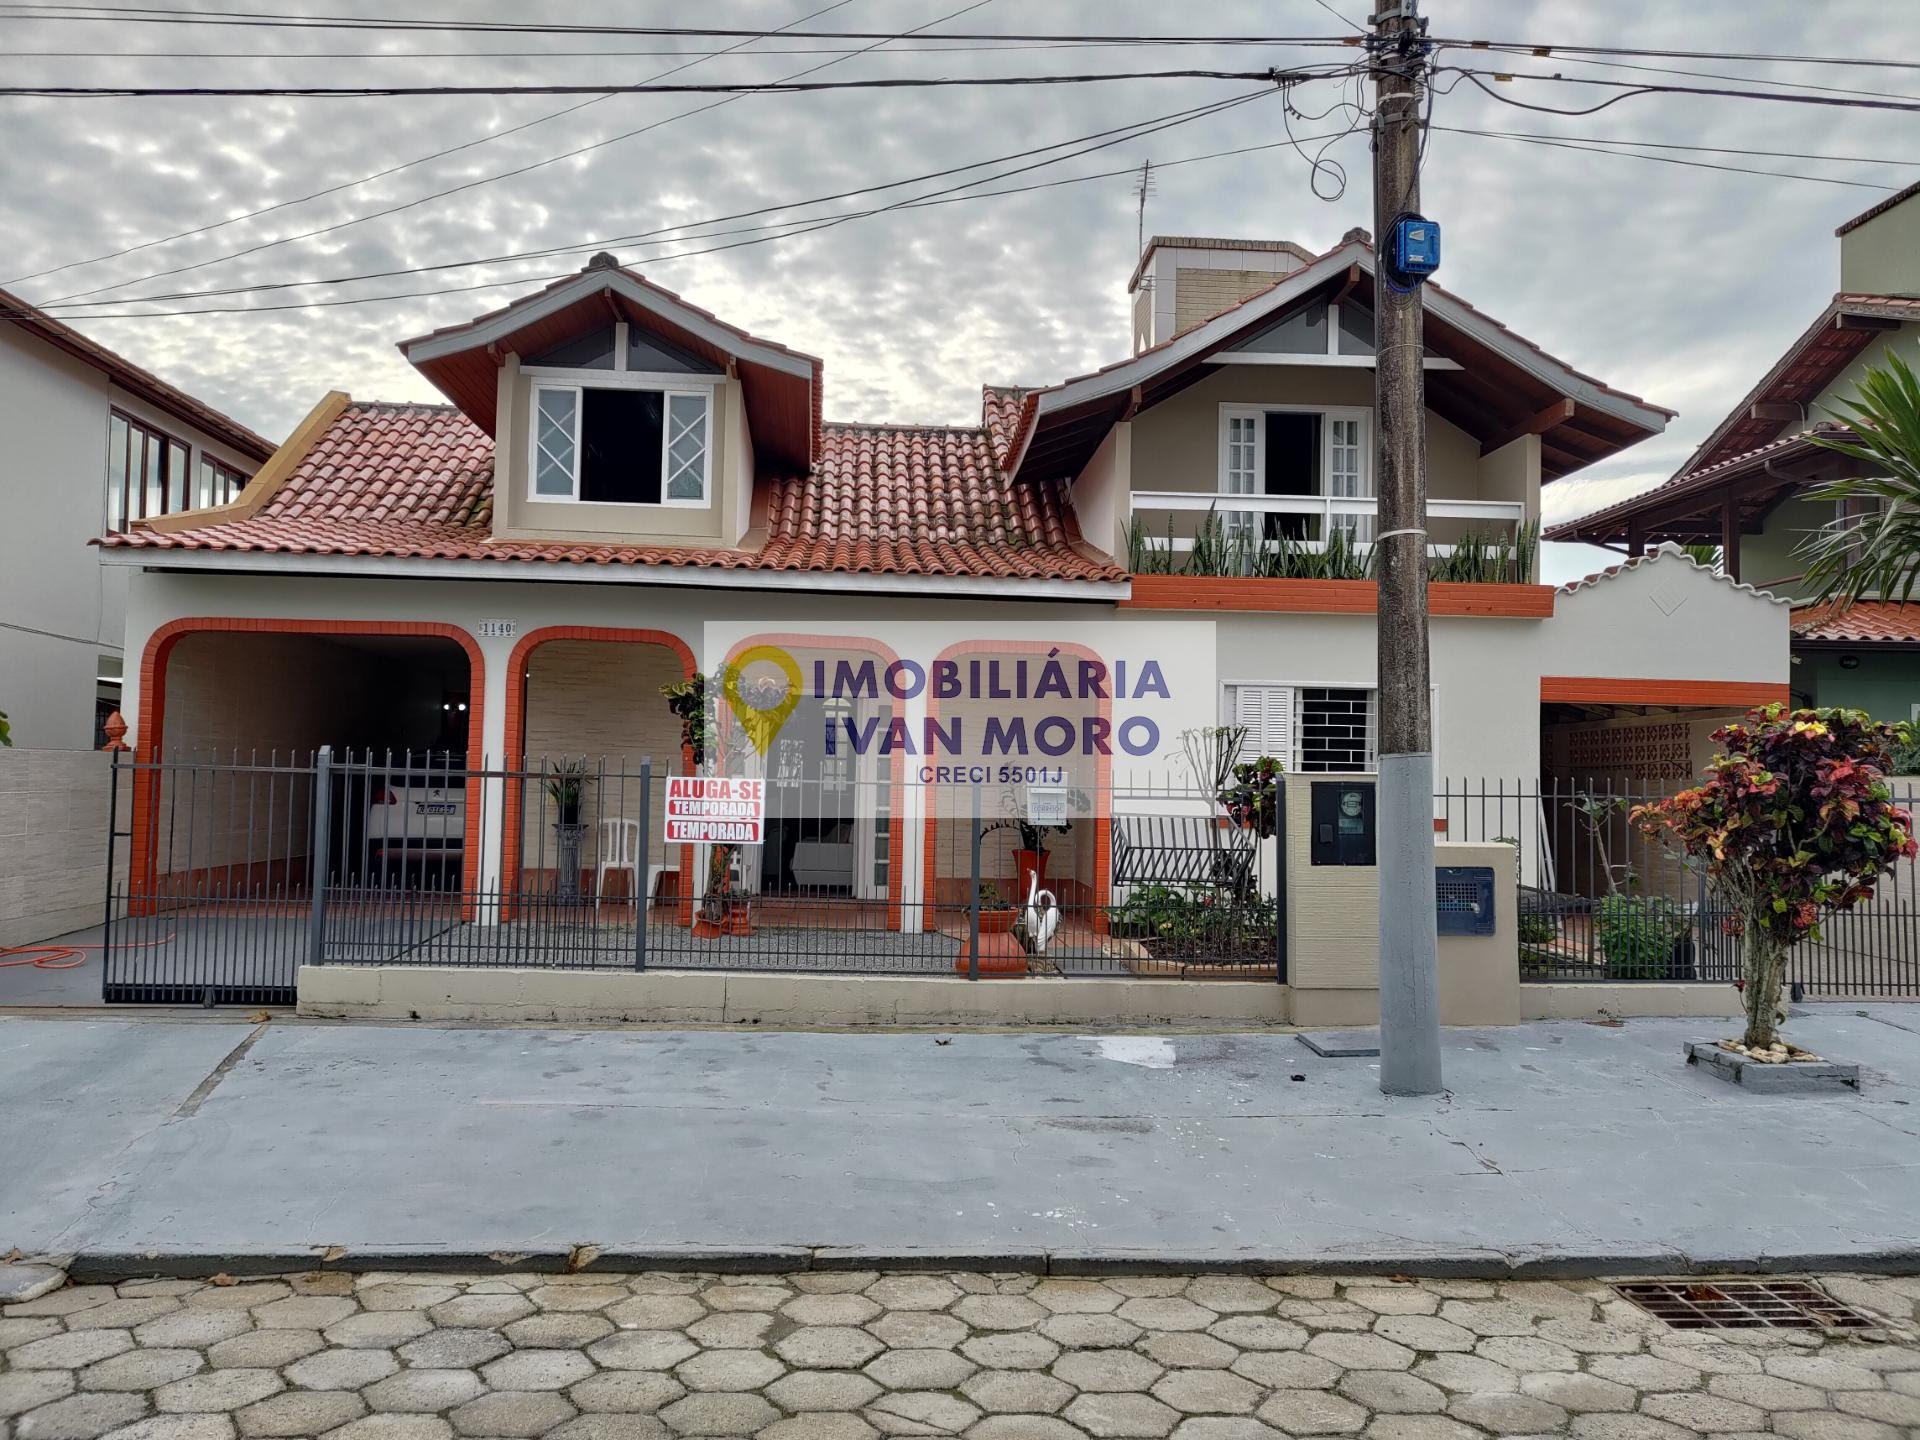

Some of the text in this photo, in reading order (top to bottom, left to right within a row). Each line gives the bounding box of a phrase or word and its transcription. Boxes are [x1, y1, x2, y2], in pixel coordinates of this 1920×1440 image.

[483, 623, 512, 633] 1140
[670, 779, 762, 800] ALUGA-SE
[674, 801, 756, 816] TEMPORADA
[671, 821, 755, 841] TEMPORADA
